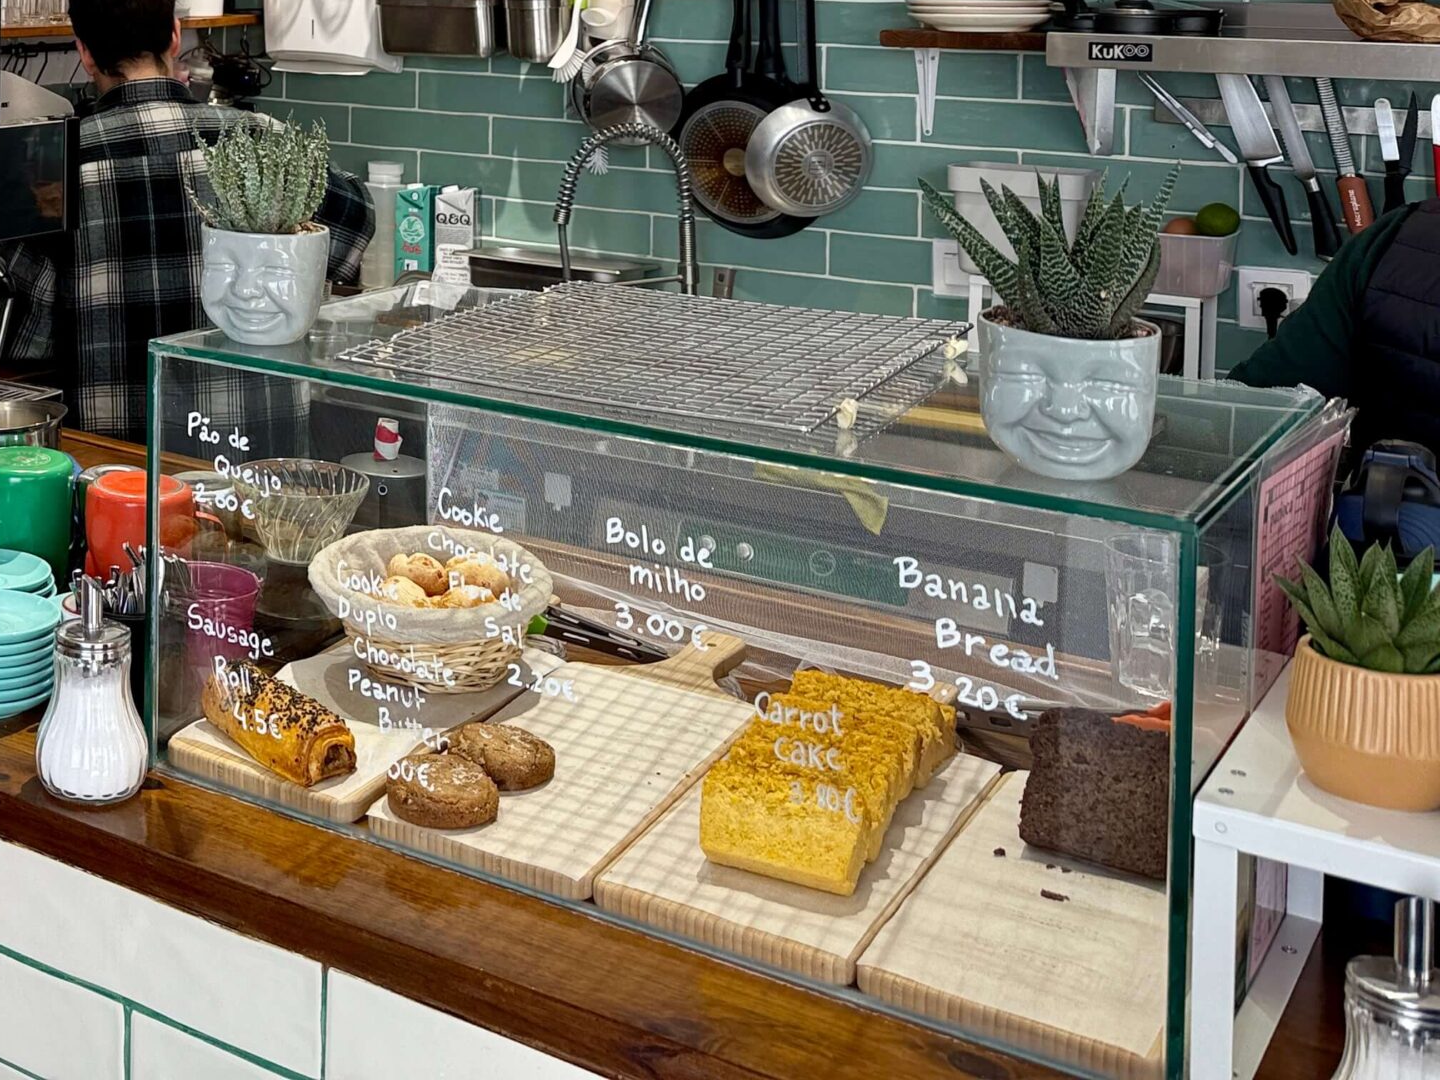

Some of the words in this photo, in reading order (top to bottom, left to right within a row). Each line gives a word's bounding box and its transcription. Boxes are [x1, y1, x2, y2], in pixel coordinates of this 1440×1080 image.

[436, 212, 472, 226] Q&Q
[187, 411, 220, 444] Pão
[228, 426, 250, 451] de
[214, 454, 282, 498] Queijo
[437, 487, 504, 534] Cookie
[427, 531, 534, 584] Chocolate
[606, 517, 666, 555] Bolo
[680, 536, 713, 568] de
[337, 559, 399, 601] Cookie
[499, 587, 522, 612] de
[630, 563, 706, 602] milho
[893, 556, 1044, 626] Banana
[187, 603, 274, 660] Sausage
[338, 595, 398, 637] Duplo
[484, 616, 523, 649] Sal
[353, 636, 456, 687] Chocolate
[935, 617, 1059, 680] Bread
[214, 655, 252, 696] Roll
[348, 668, 427, 712] Peanut
[378, 706, 452, 751] Butter
[754, 691, 845, 737] Carrot
[773, 736, 843, 772] Cake
